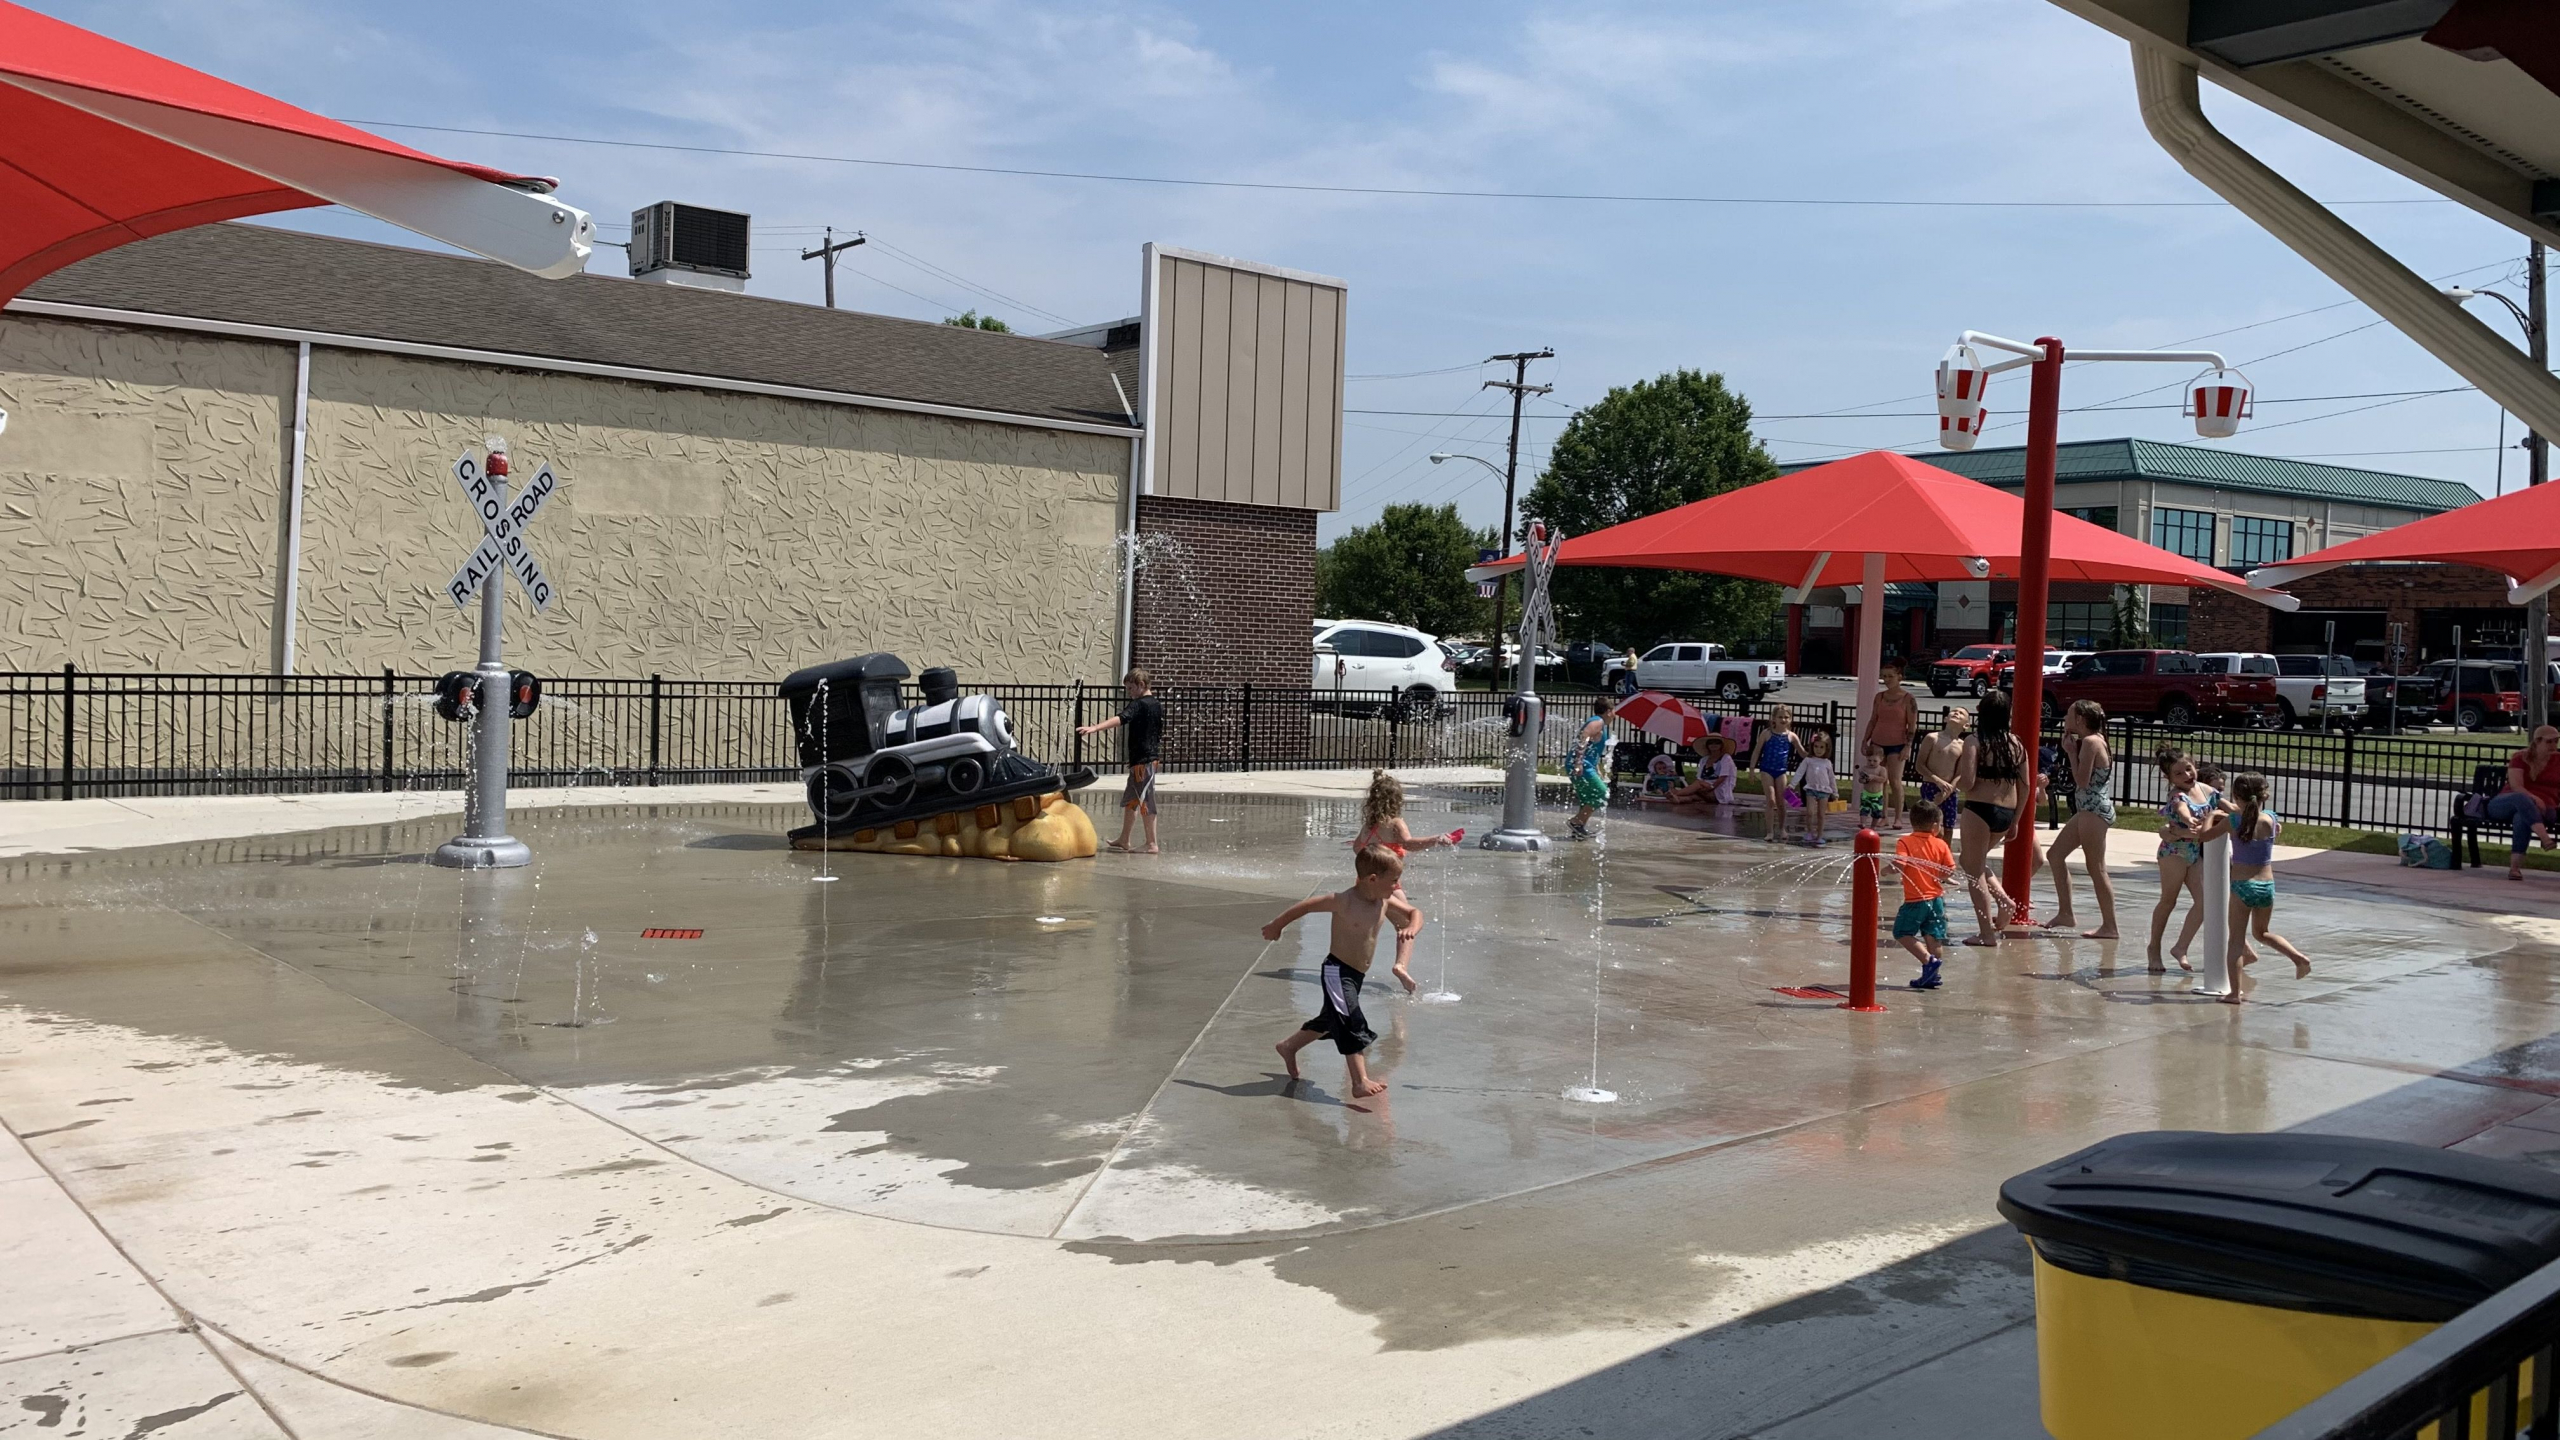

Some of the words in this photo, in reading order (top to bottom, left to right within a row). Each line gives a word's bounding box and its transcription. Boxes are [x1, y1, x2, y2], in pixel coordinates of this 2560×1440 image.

[451, 548, 499, 604] RAIL
[511, 471, 553, 527] ROAD
[459, 459, 549, 605] CROSSING
[1521, 599, 1539, 643] RAIL
